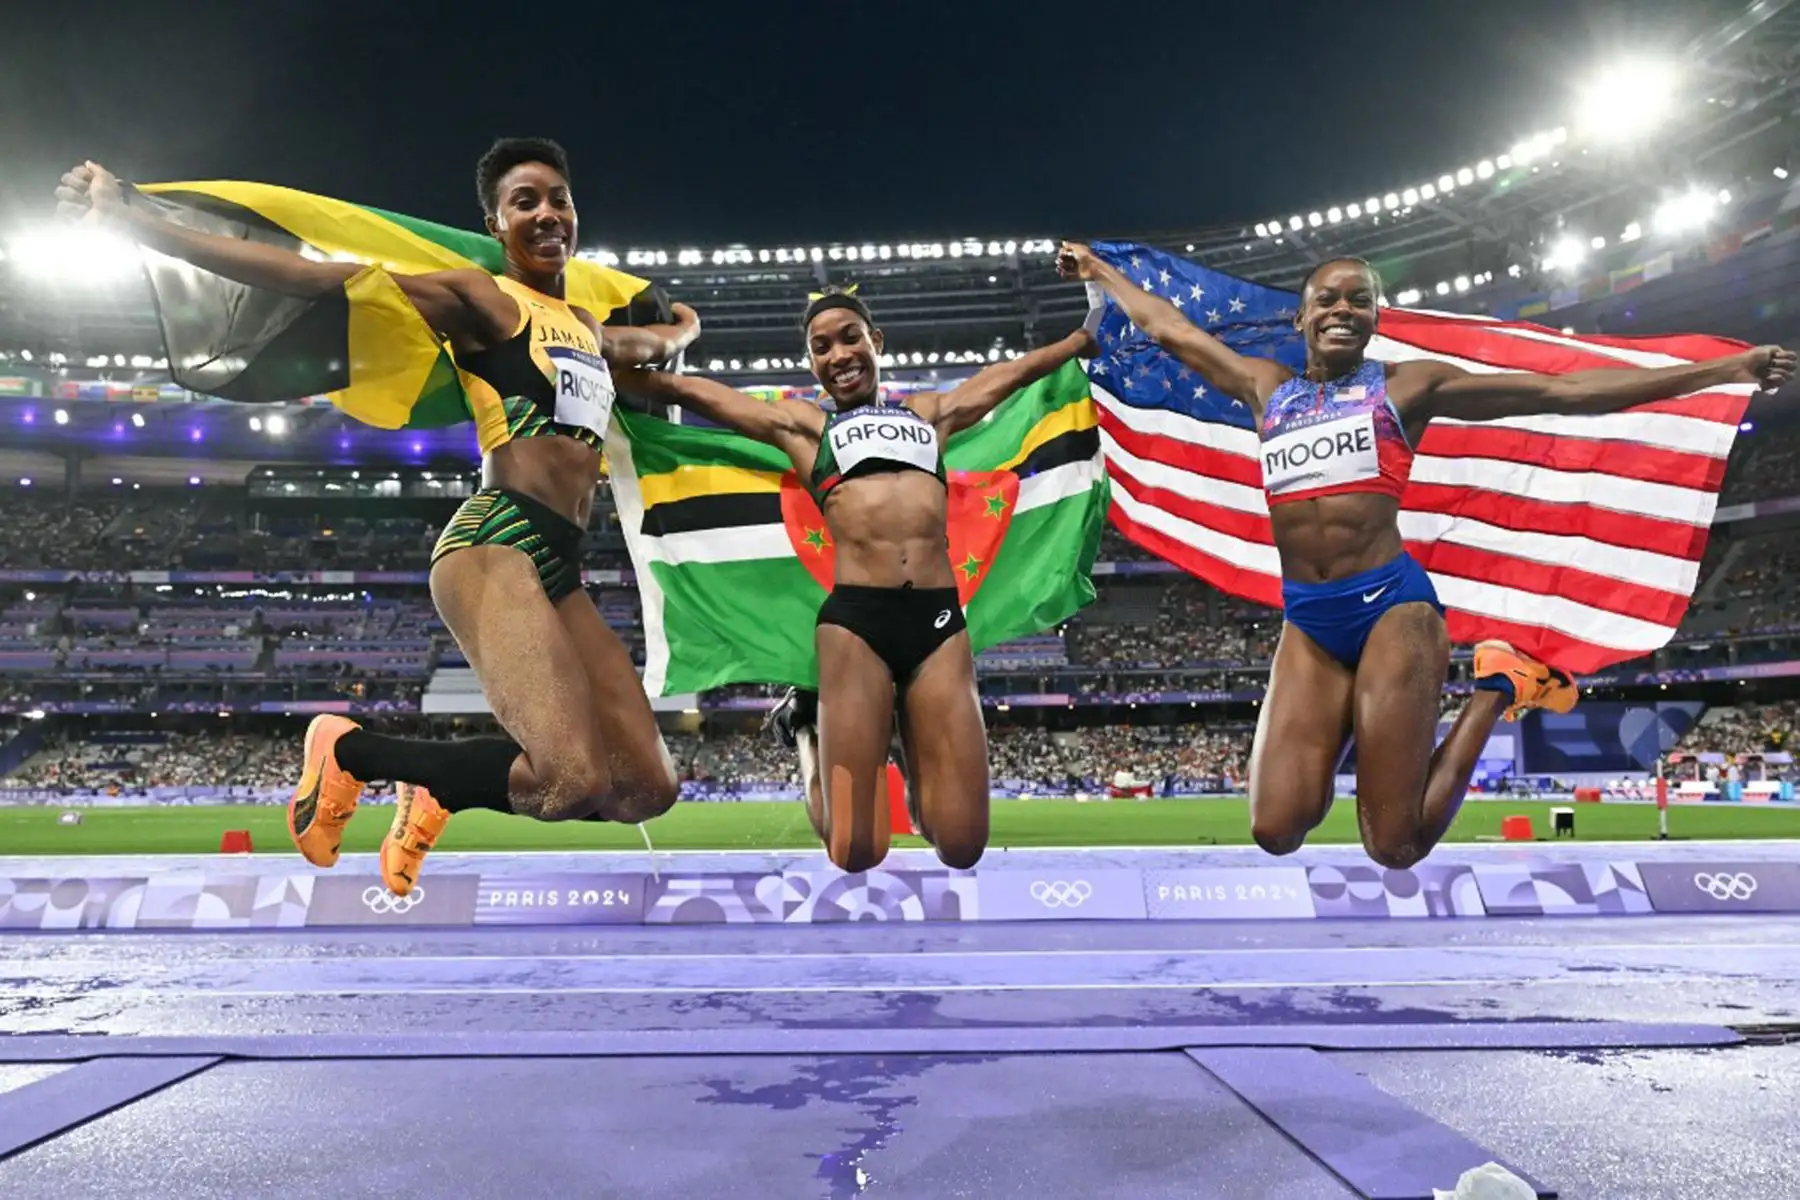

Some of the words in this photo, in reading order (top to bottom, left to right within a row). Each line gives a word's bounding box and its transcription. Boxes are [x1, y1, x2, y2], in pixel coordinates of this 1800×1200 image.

[834, 423, 932, 450] LAFOND
[1266, 427, 1371, 475] MOORE
[489, 890, 559, 906] PARIS
[567, 889, 630, 906] 2024
[1158, 885, 1226, 901] PARIS
[1235, 884, 1297, 900] 2024
